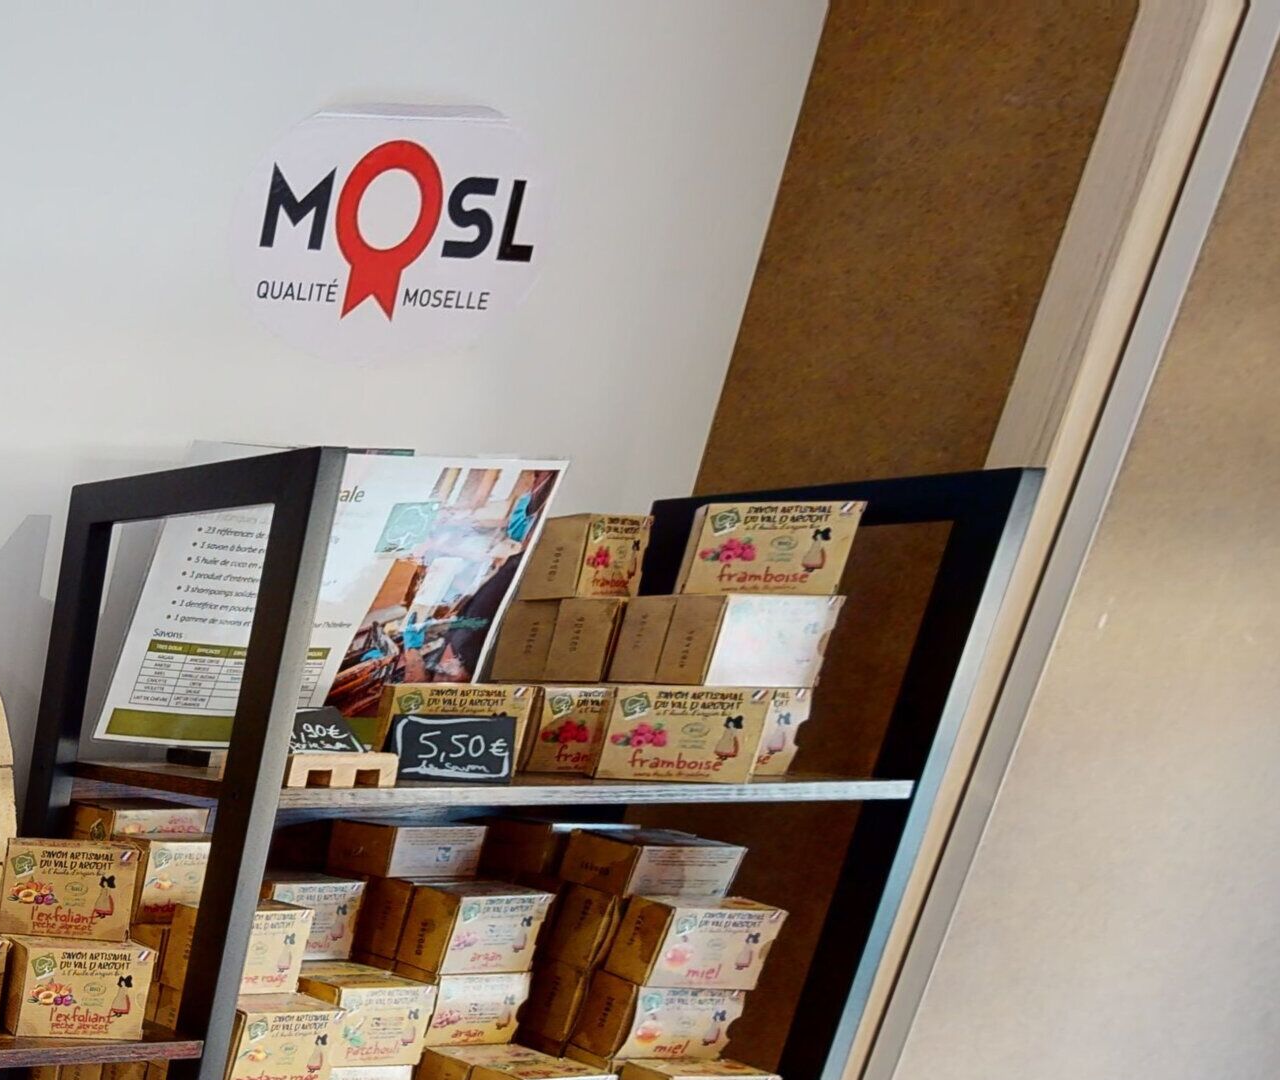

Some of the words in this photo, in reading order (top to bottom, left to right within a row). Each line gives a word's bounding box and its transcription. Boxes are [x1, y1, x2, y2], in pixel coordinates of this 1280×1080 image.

[259, 140, 534, 264] MOSL
[256, 279, 339, 303] QUALITÉ
[403, 287, 490, 311] MOSELLE
[717, 563, 811, 584] framboise
[153, 628, 183, 639] Savons
[627, 751, 723, 772] framboise
[685, 964, 722, 980] miel
[346, 1043, 401, 1057] patchouli
